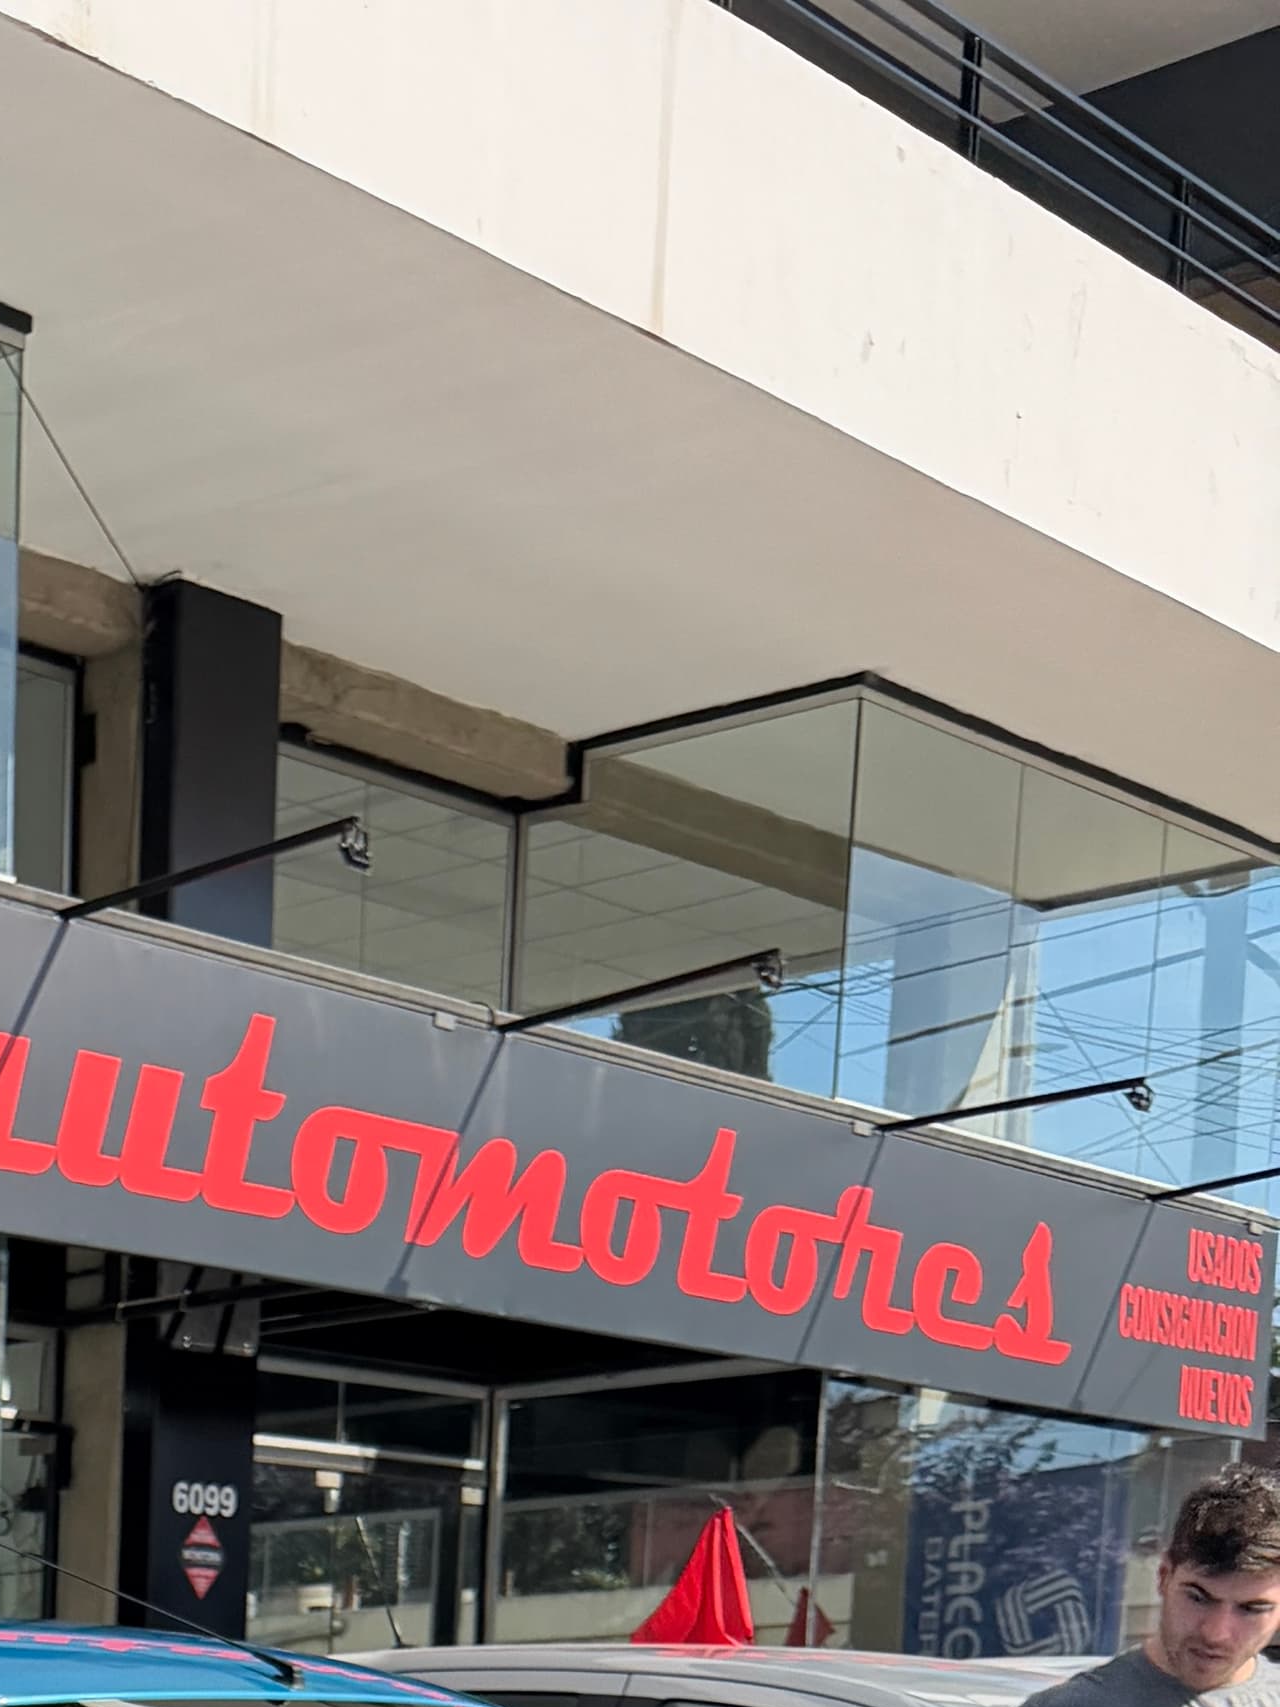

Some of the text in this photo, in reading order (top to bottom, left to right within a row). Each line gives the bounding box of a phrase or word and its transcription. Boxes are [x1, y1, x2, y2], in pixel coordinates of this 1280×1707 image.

[1187, 1228, 1263, 1295] USADOS
[1119, 1283, 1259, 1362] CONSIGNACION
[1178, 1364, 1254, 1428] NUEVOS
[171, 1481, 238, 1518] 6099
